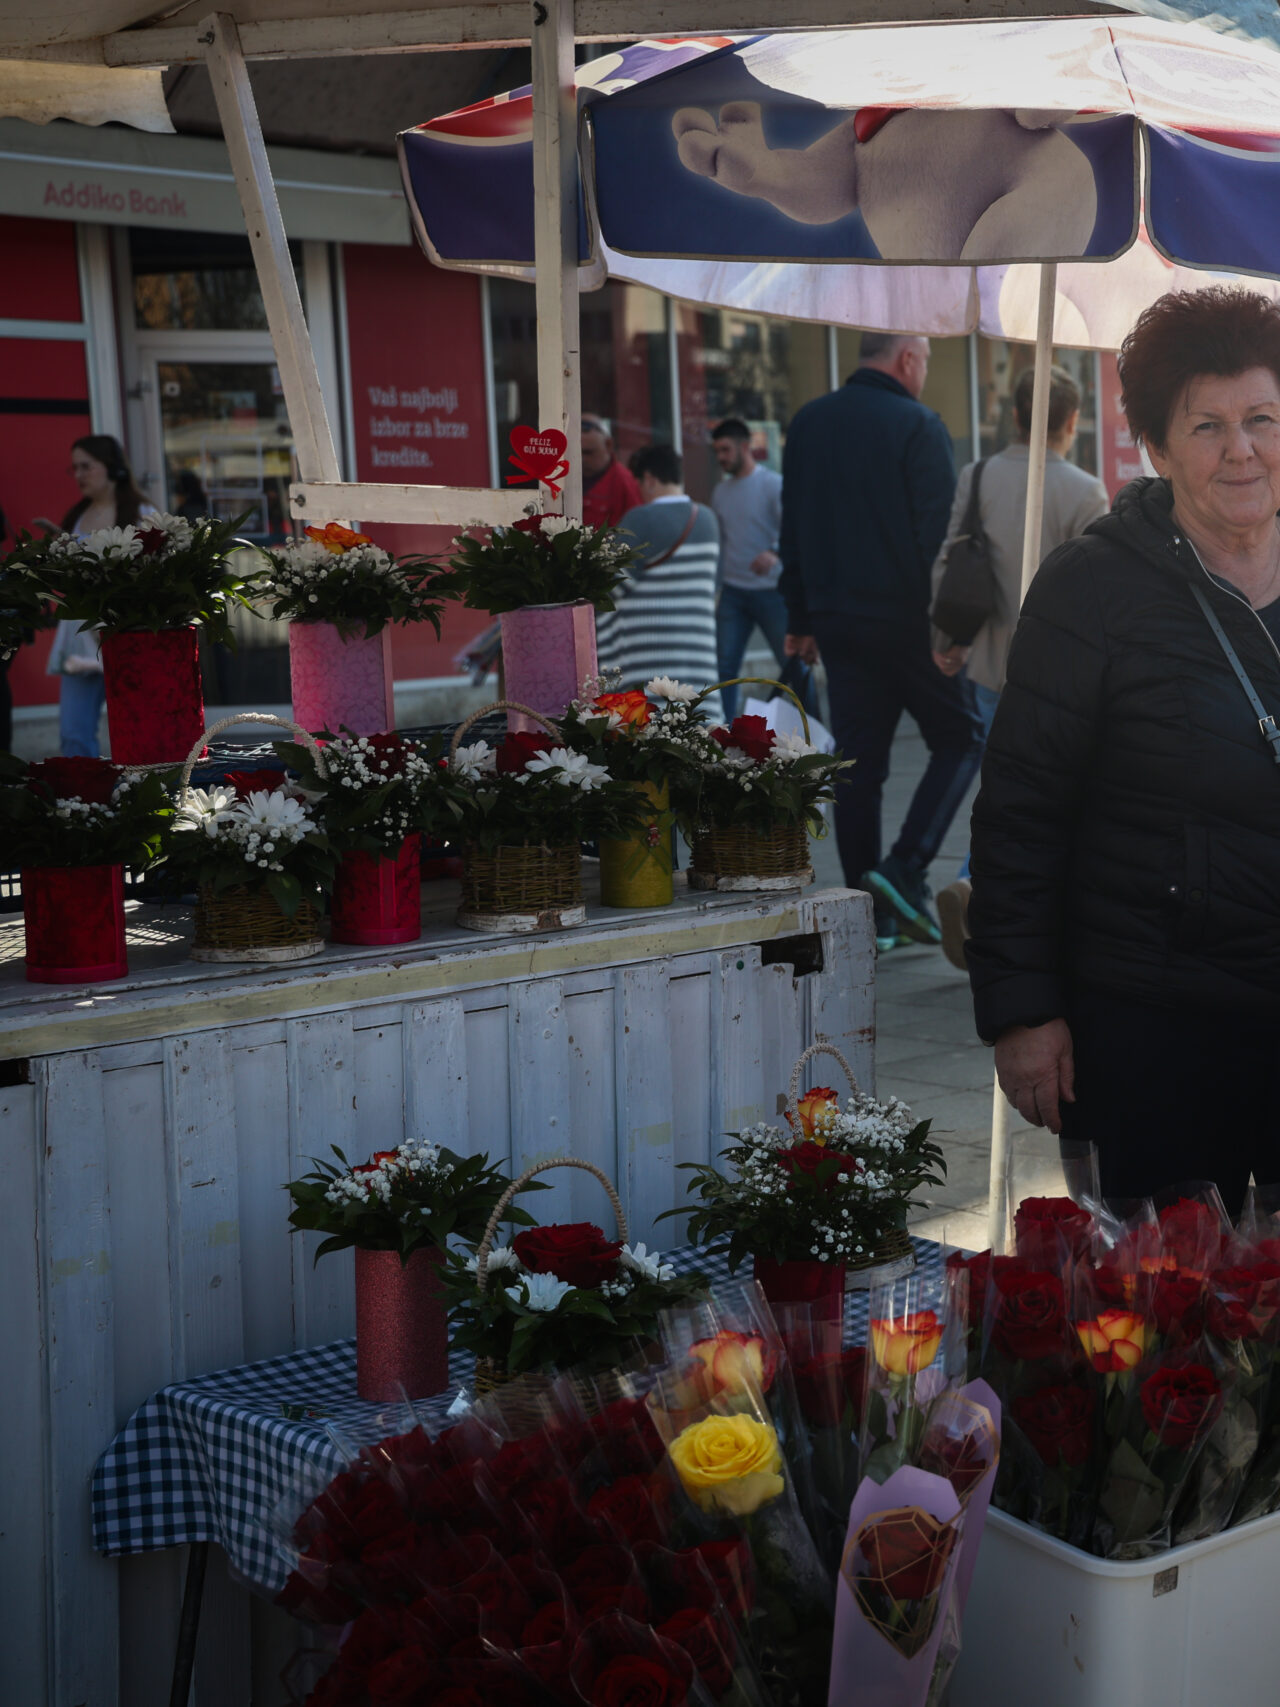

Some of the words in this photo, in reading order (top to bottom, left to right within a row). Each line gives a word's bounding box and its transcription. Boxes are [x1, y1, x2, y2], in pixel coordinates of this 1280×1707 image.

[43, 181, 126, 212] Addiko
[129, 188, 187, 217] Bank
[367, 386, 398, 407] Vaš
[400, 386, 459, 414] najbolji
[369, 416, 411, 438] izbor
[414, 421, 432, 438] za
[433, 417, 469, 439] brze
[529, 437, 551, 446] FELIZ
[371, 444, 434, 468] kredite.
